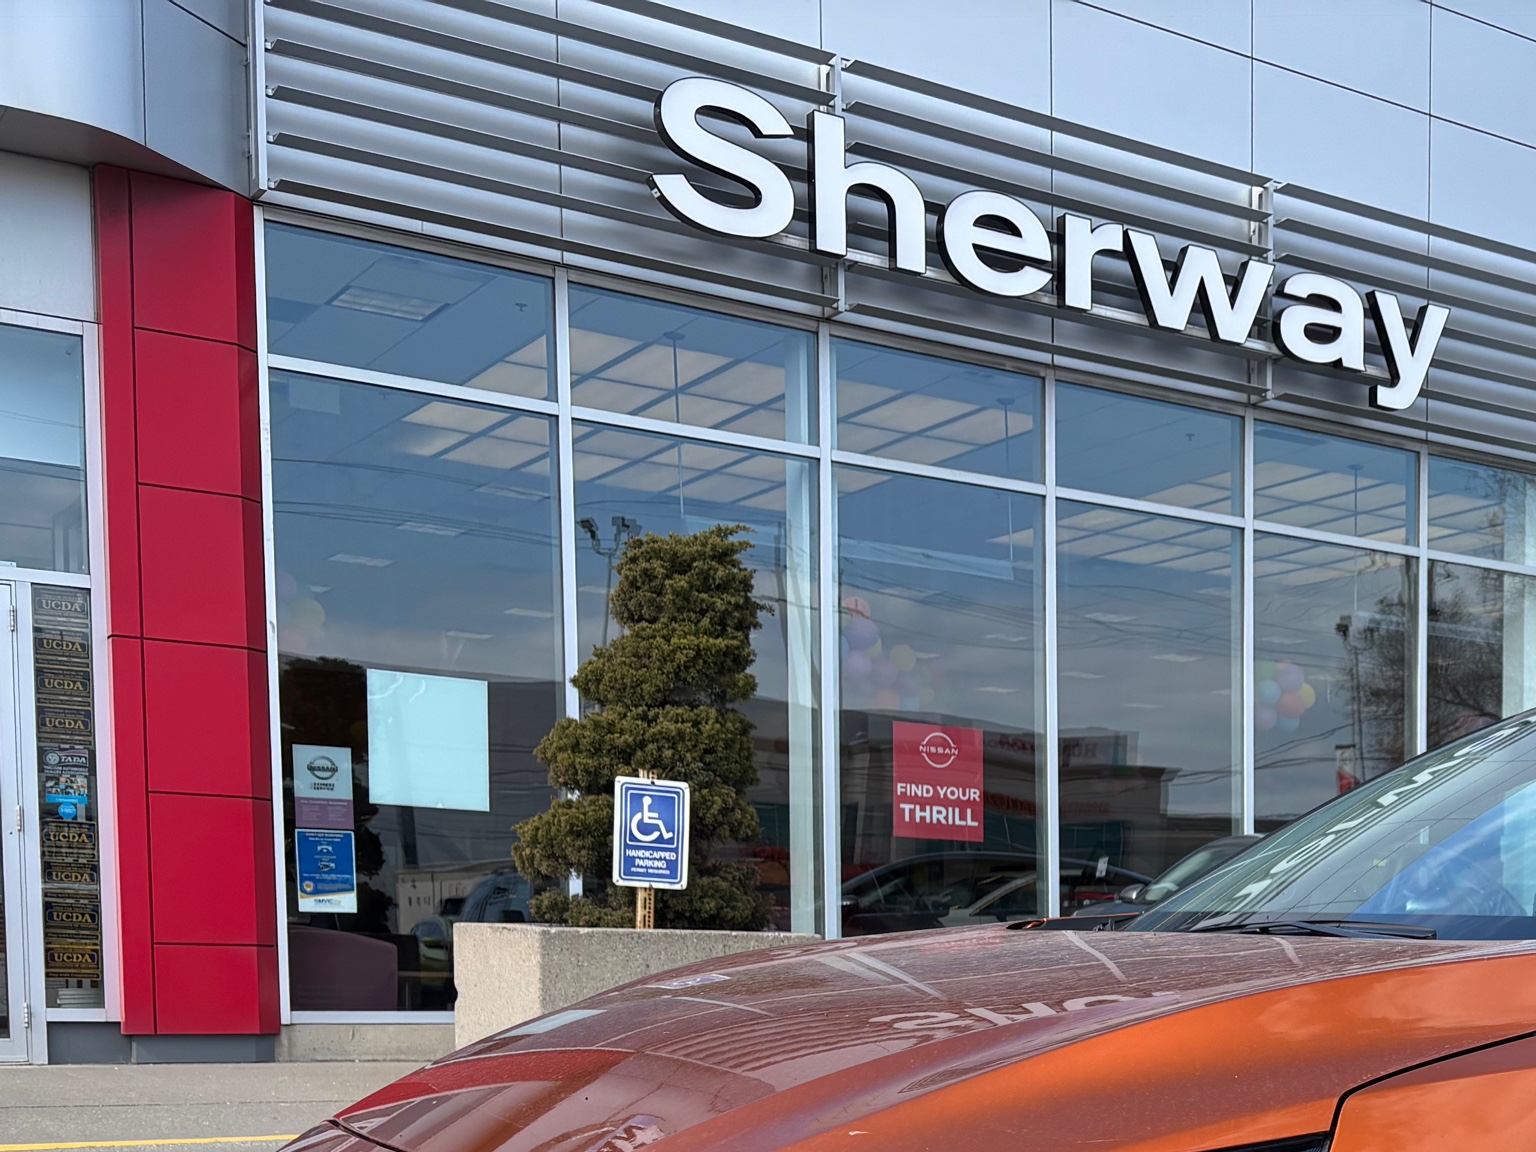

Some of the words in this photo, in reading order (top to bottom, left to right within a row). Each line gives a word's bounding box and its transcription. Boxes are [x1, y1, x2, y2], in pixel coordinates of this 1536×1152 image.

[648, 77, 1451, 409] Sherway
[42, 600, 81, 611] UCDA
[43, 639, 82, 651] UCDA
[44, 678, 84, 690] UCDA
[45, 717, 85, 729] UCDA
[919, 745, 958, 755] NISSAN
[897, 783, 933, 798] FIND
[937, 786, 980, 801] YOUR
[900, 803, 979, 826] THRILL
[50, 832, 89, 843] UCDA
[626, 849, 676, 860] HANDICAPPED
[635, 858, 667, 868] PARKING
[52, 871, 91, 882] UCDA
[53, 911, 92, 923] UCDA
[54, 953, 92, 963] UCDA
